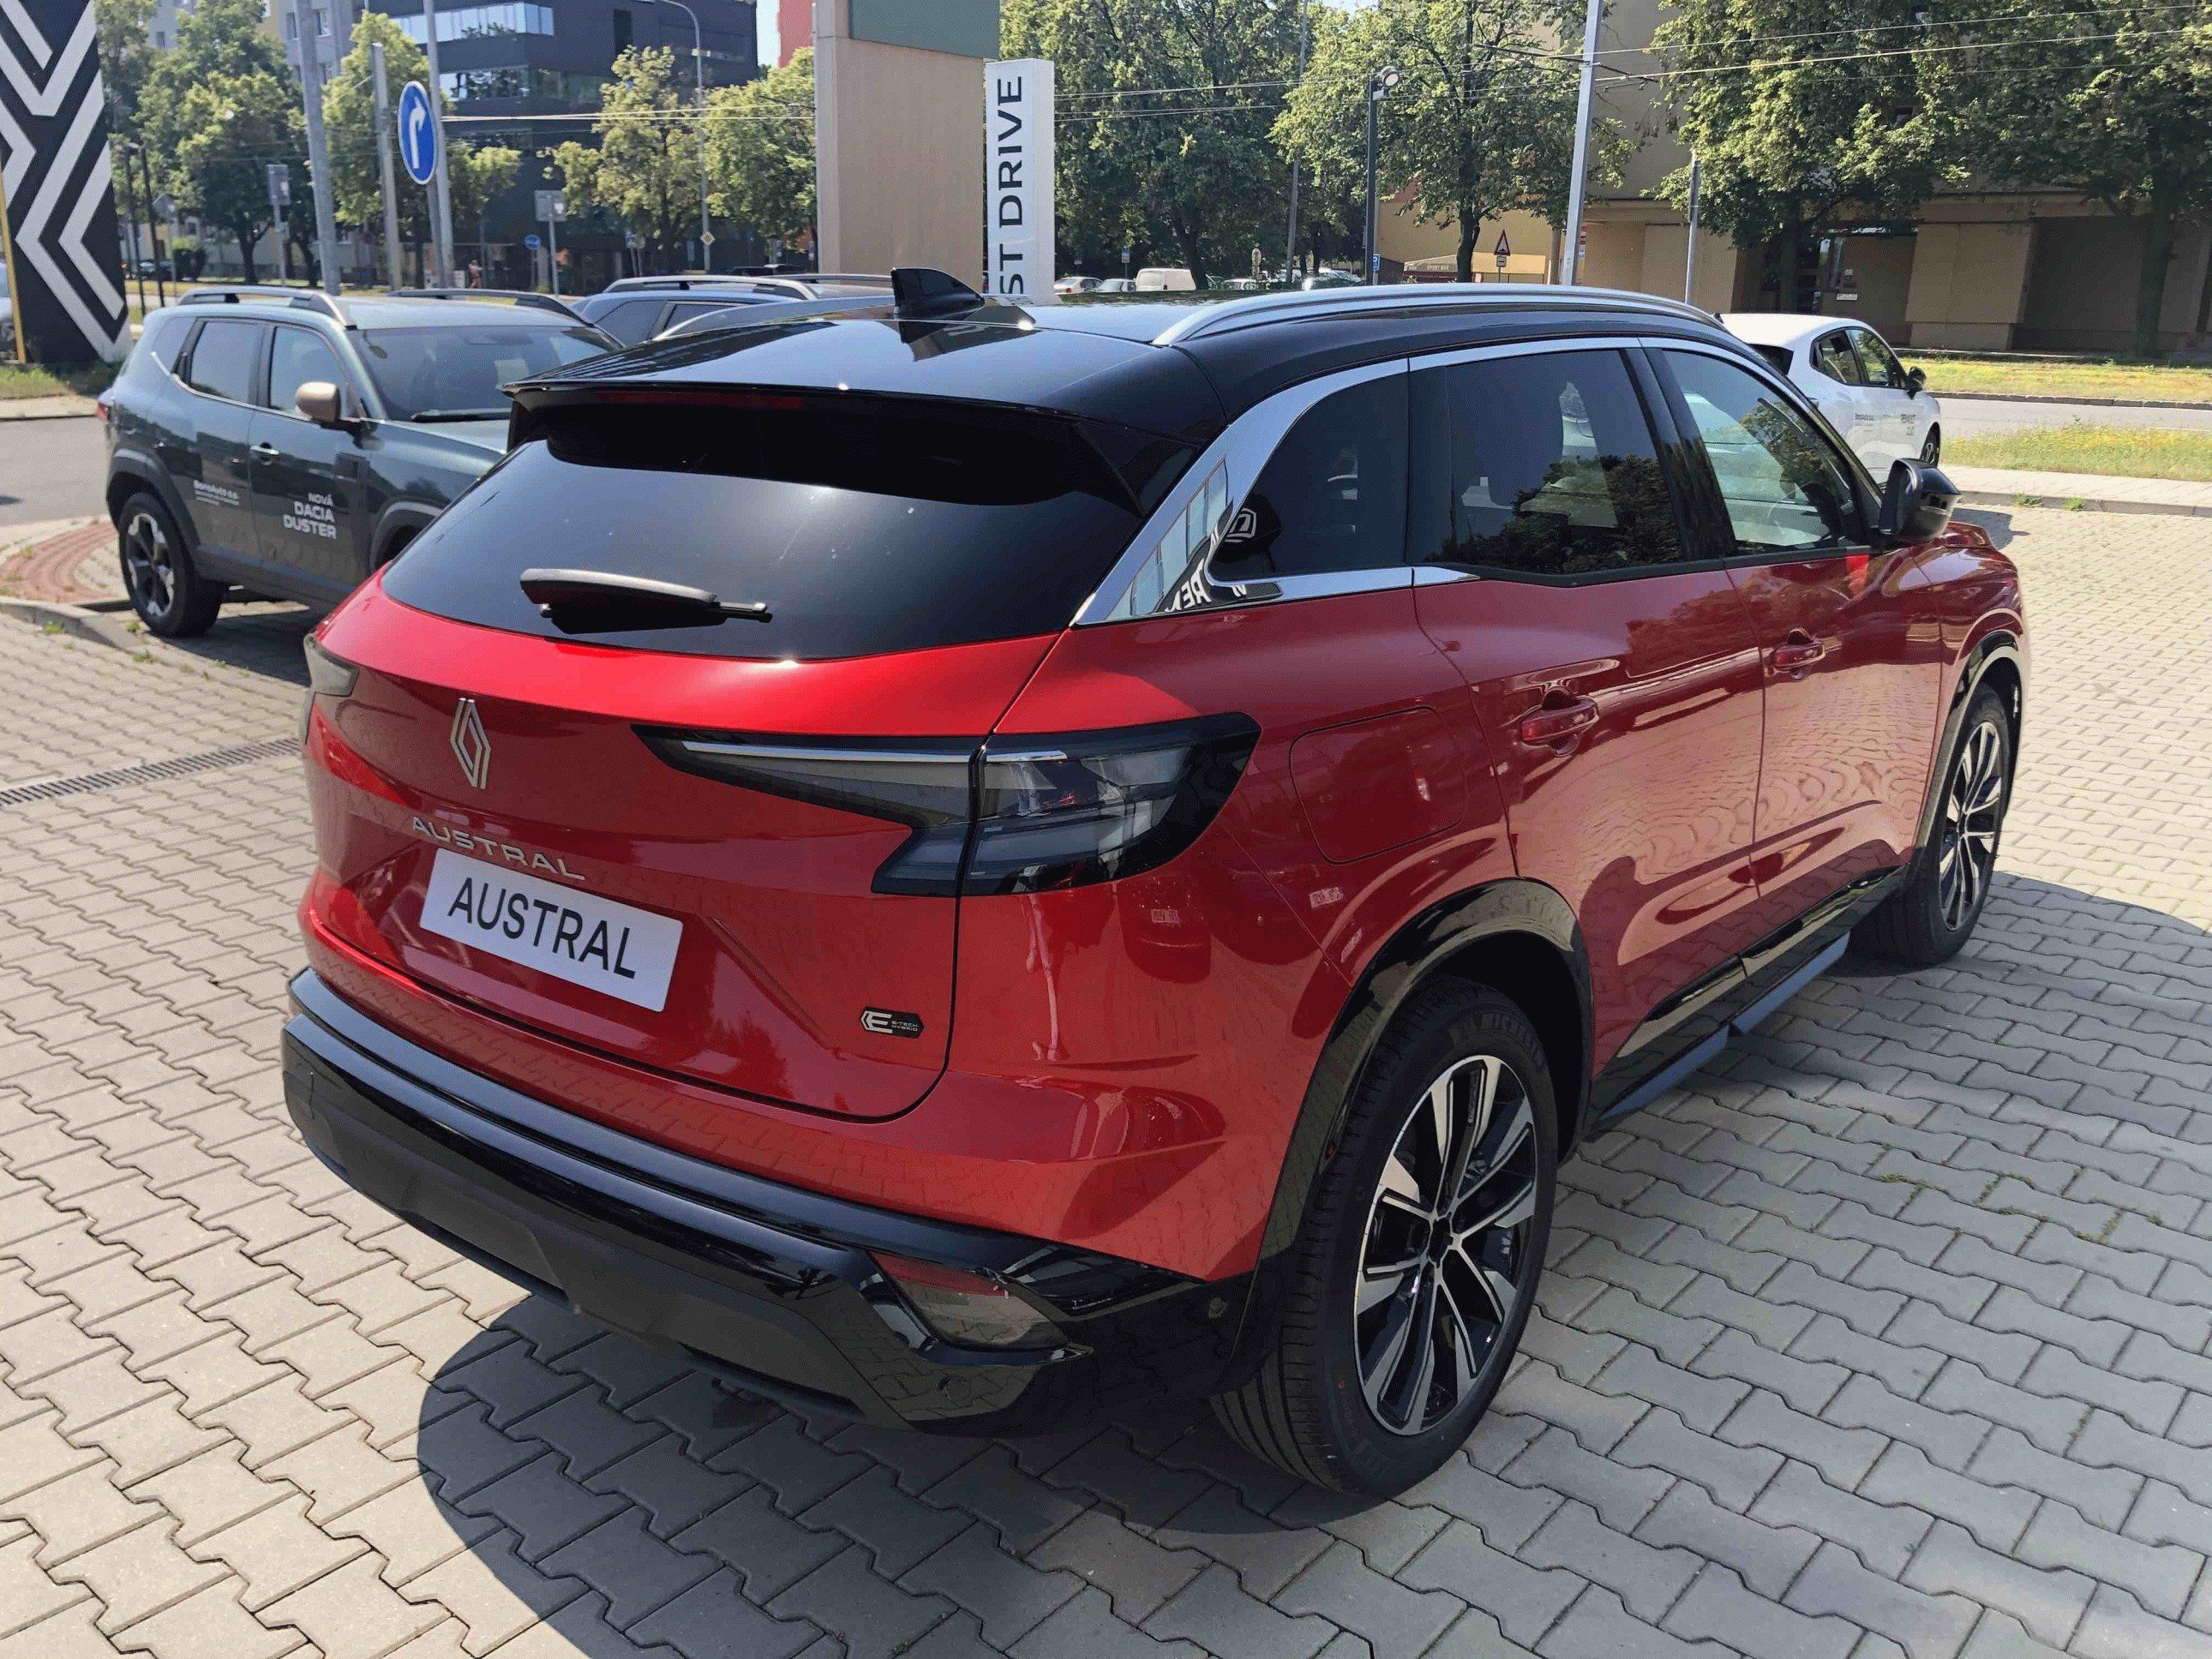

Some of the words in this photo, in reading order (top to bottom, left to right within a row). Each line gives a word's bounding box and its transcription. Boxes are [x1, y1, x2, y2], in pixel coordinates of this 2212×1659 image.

[998, 76, 1022, 228] DRIVE
[999, 243, 1023, 294] ST
[293, 500, 336, 523] DACIA
[308, 492, 334, 507] NOVÁ
[283, 514, 337, 540] DUSTER
[412, 816, 585, 881] AUSTRAL
[447, 877, 636, 979] AUSTRAL
